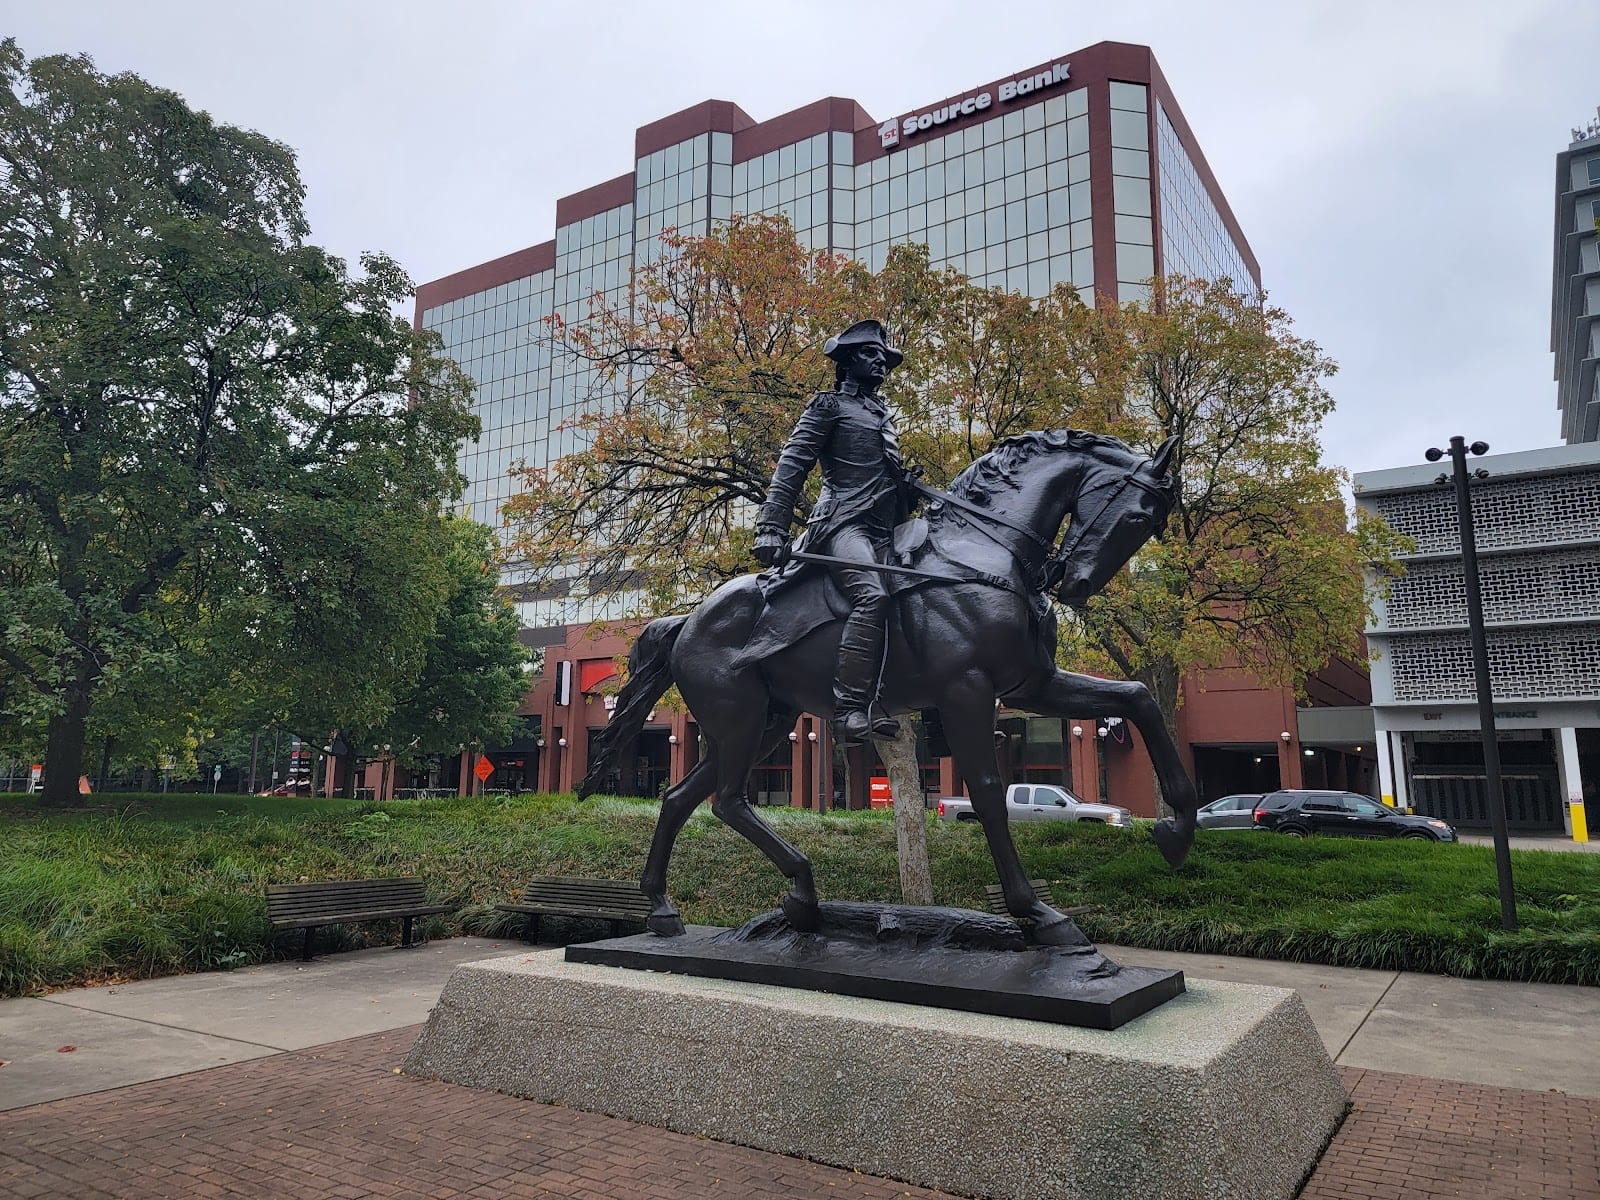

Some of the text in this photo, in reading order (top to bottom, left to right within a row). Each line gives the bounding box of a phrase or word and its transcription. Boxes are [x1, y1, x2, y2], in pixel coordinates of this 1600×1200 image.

[903, 92, 992, 136] Source
[998, 63, 1071, 102] Bank
[1493, 710, 1538, 719] NTRANCE
